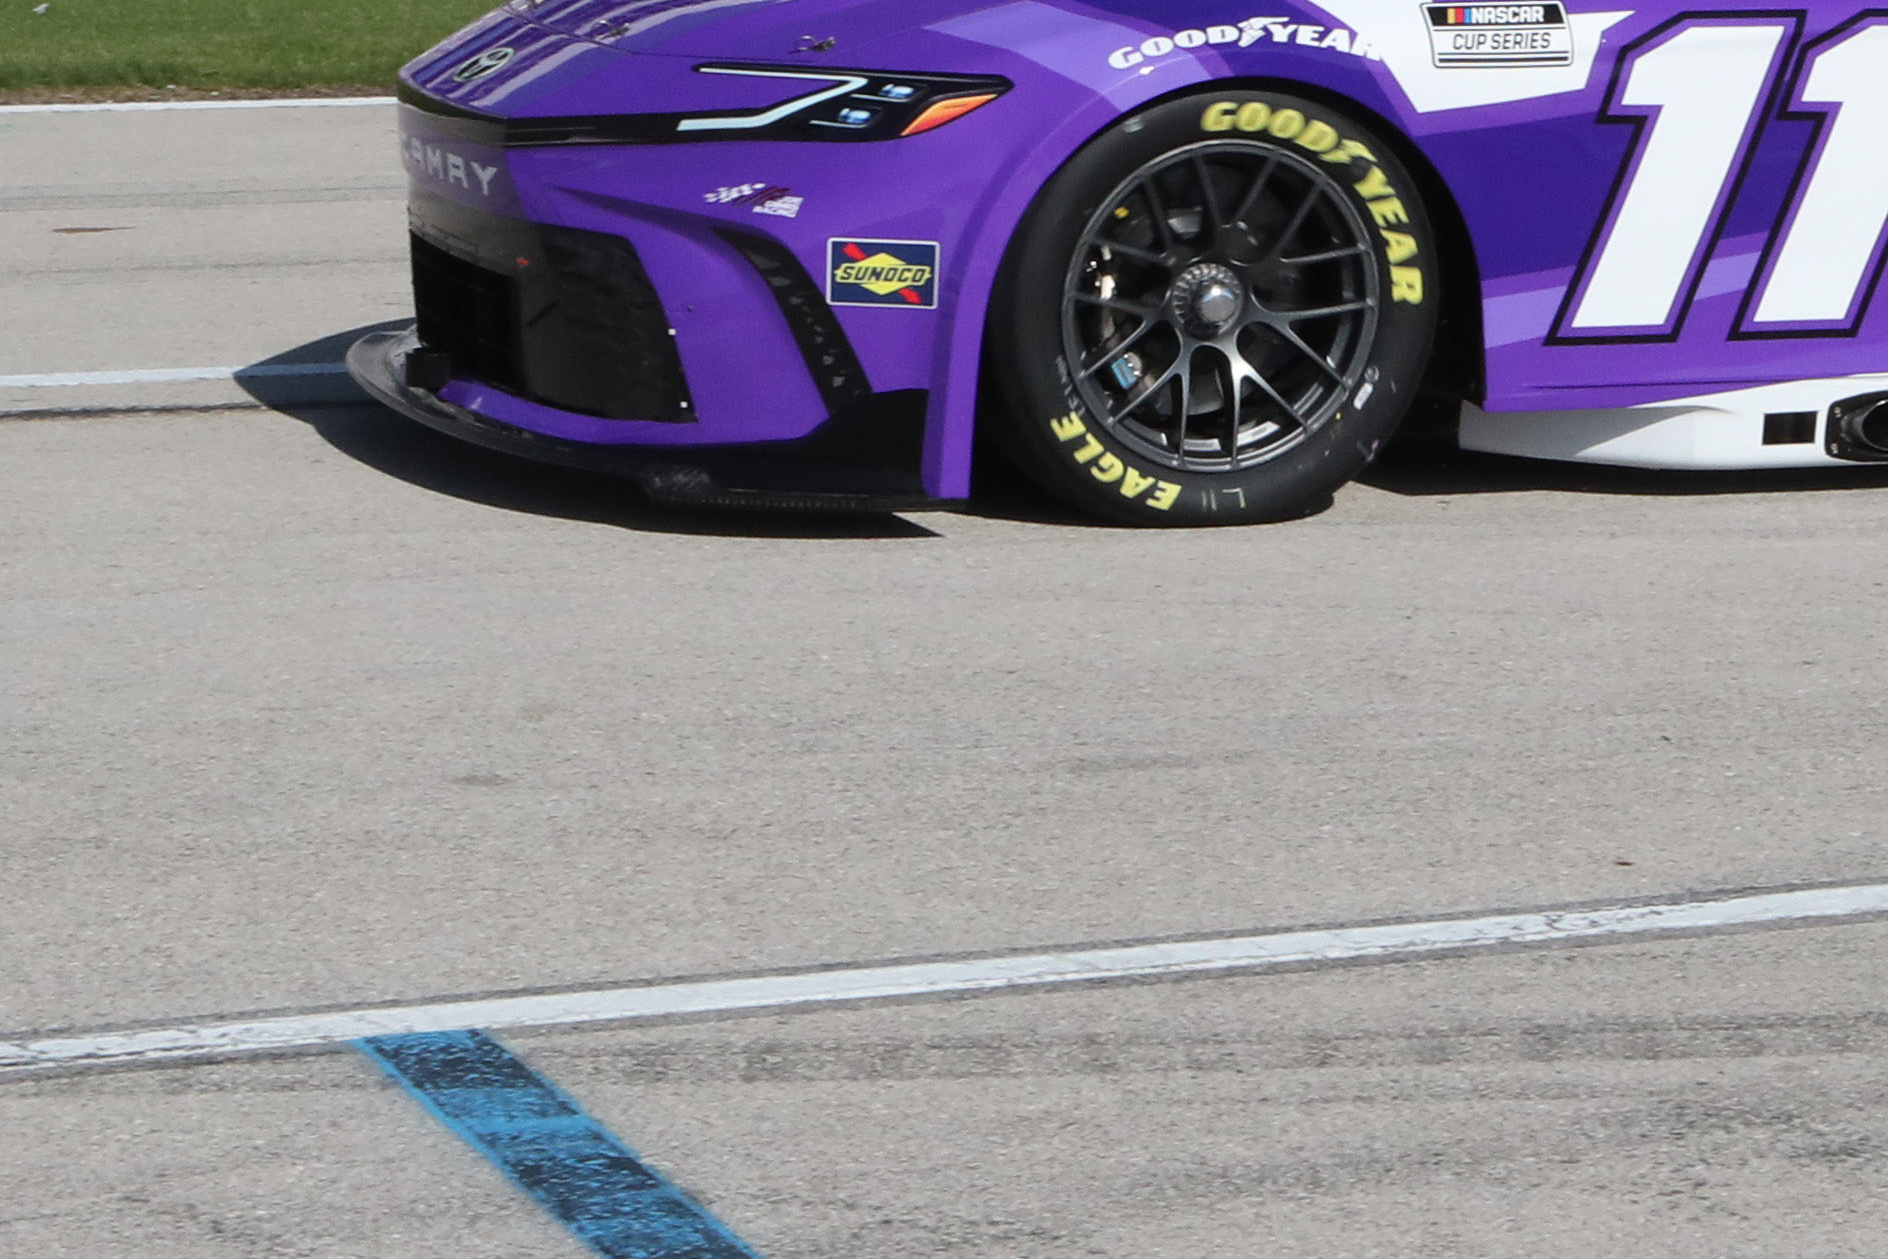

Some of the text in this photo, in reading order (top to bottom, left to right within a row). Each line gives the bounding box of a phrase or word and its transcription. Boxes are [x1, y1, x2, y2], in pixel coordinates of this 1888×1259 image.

[1471, 6, 1545, 23] NASCAR
[1453, 32, 1551, 50] CUP SERIES
[839, 266, 927, 283] SUNOCO
[1050, 411, 1182, 511] EAGLE
